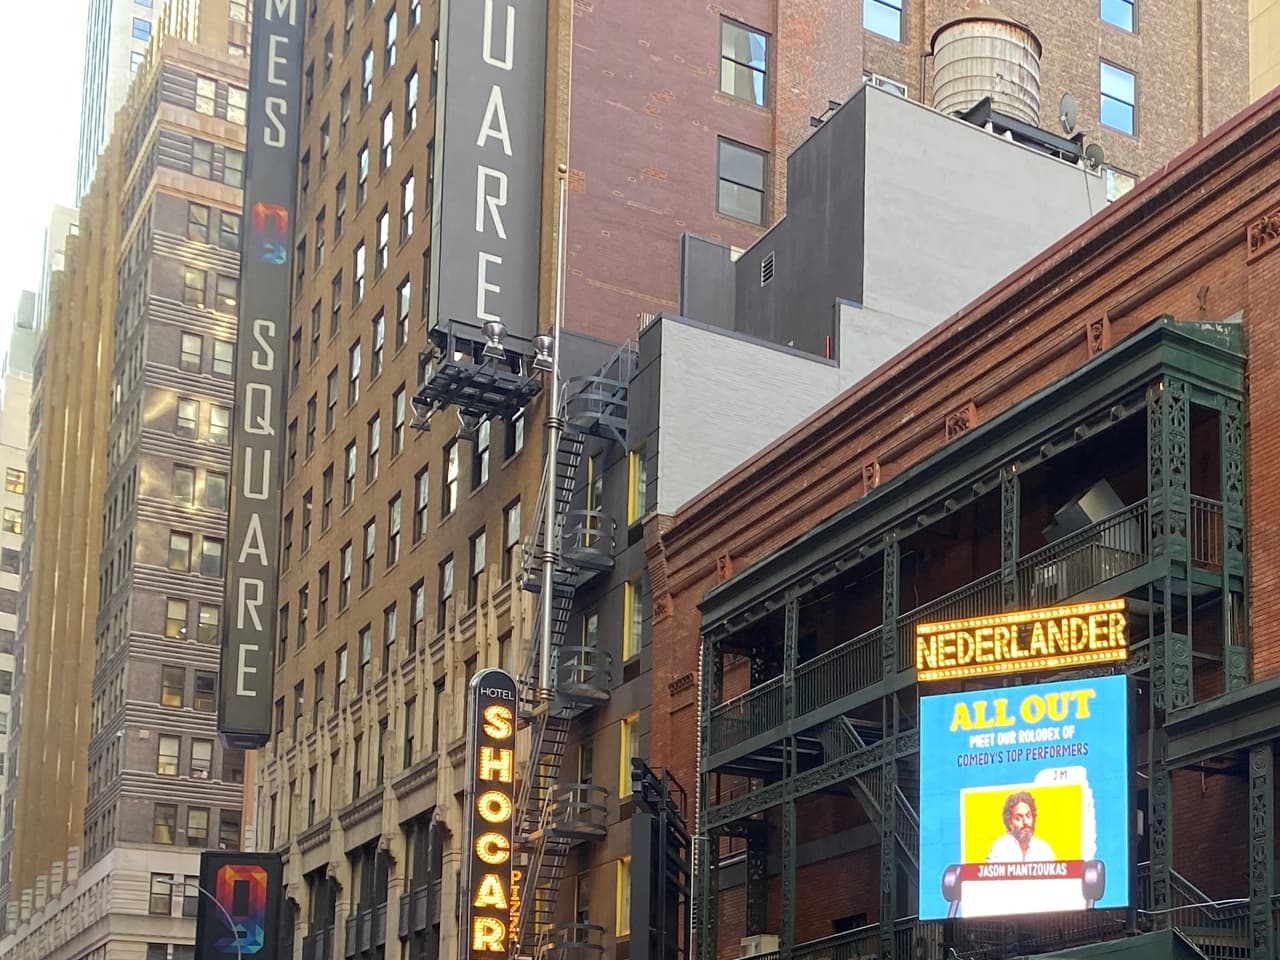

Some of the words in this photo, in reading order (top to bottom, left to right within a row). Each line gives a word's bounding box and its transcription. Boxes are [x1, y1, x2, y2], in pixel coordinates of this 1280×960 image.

[474, 0, 516, 322] UARE
[235, 319, 276, 698] SQUARE
[916, 611, 1128, 670] NEDERLANDER
[480, 686, 516, 701] HOTEL
[950, 699, 1016, 731] ALL
[1021, 690, 1096, 723] OUT
[969, 732, 996, 749] MEET
[997, 731, 1017, 746] OUR
[1019, 726, 1061, 744] ROLODEX
[1062, 724, 1076, 740] OF
[957, 750, 1004, 768] COMEDY'S
[1006, 749, 1024, 763] TOP
[1026, 742, 1090, 762] PERFORMERS
[977, 864, 1006, 879] JASON
[1007, 862, 1068, 877] MANTZOUKAS
